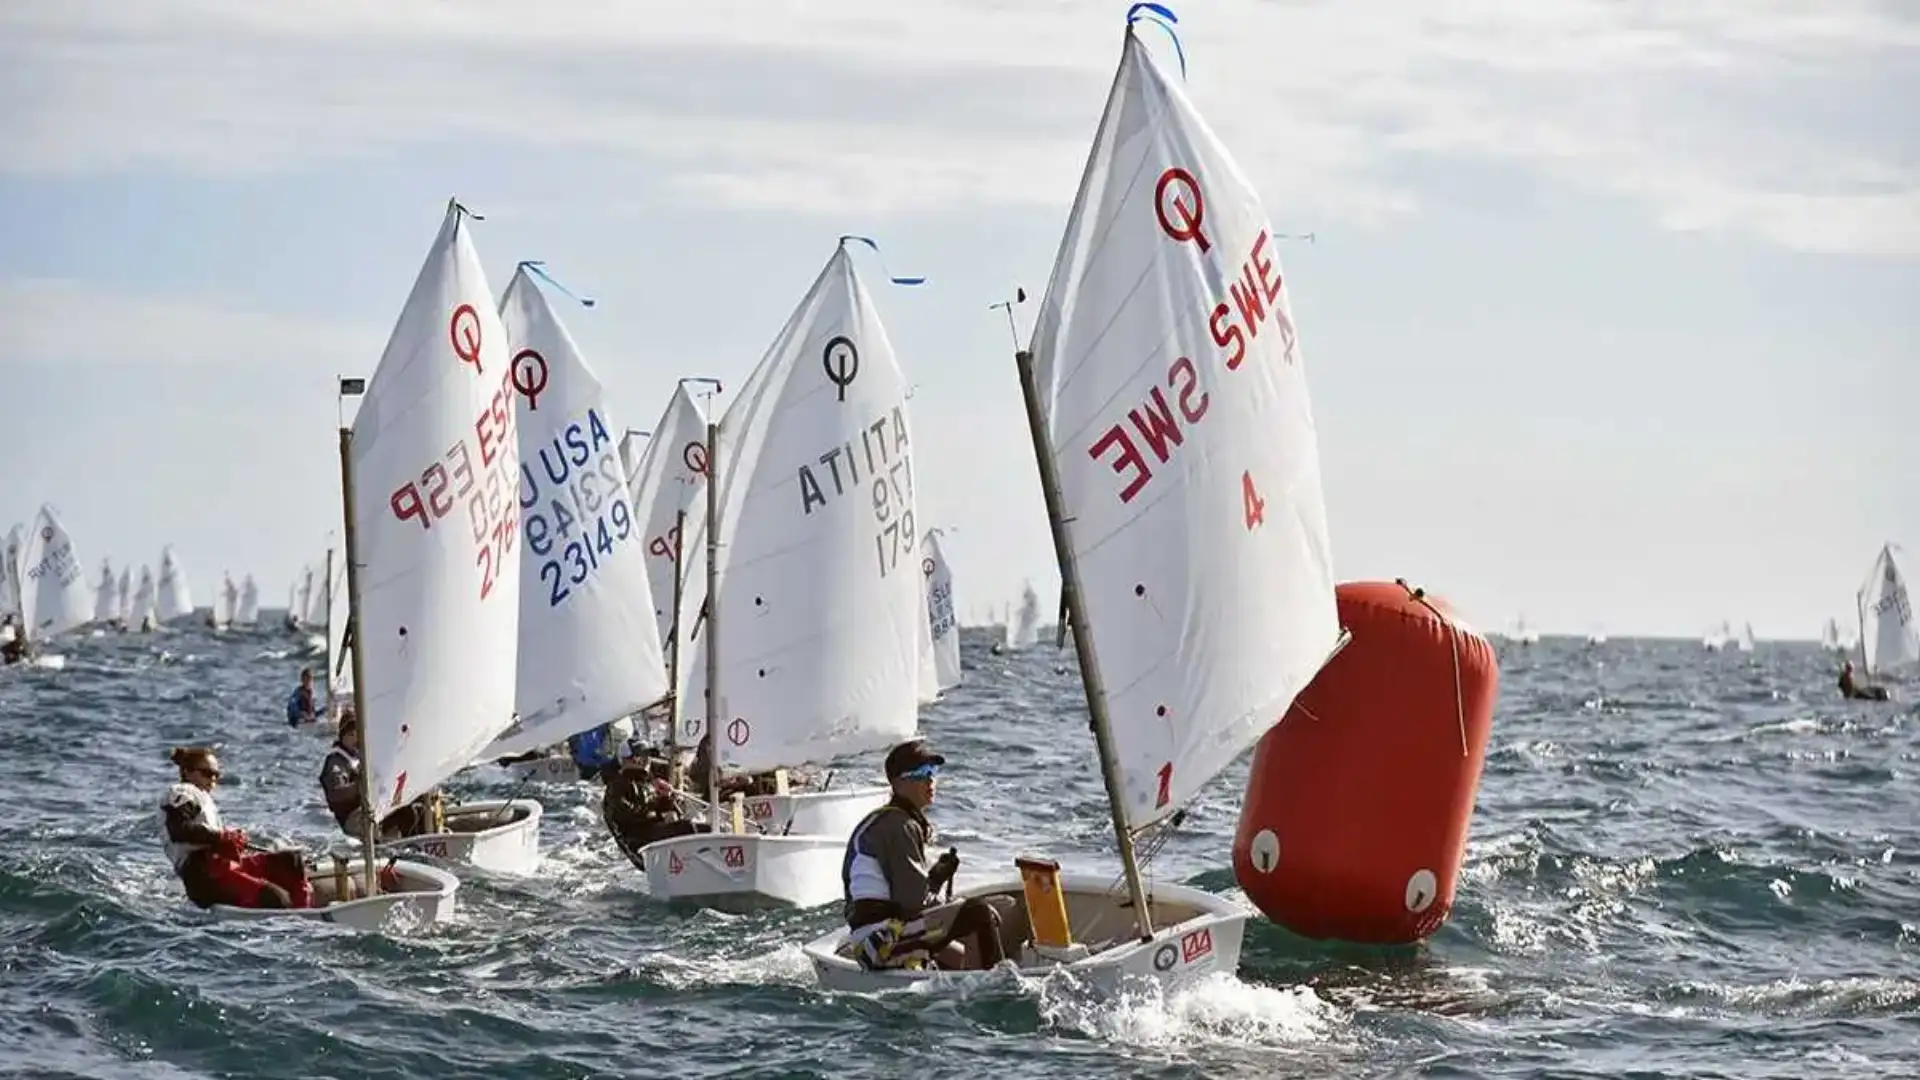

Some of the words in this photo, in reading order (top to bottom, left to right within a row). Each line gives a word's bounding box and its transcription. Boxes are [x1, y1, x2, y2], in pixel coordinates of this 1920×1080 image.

[1209, 229, 1282, 371] SWE
[476, 371, 513, 468] ESP
[540, 409, 609, 484] USA
[862, 405, 908, 474] ITA
[1242, 469, 1265, 530] 4
[477, 501, 516, 600] 276
[541, 500, 630, 606] 23149
[876, 509, 915, 578] 179
